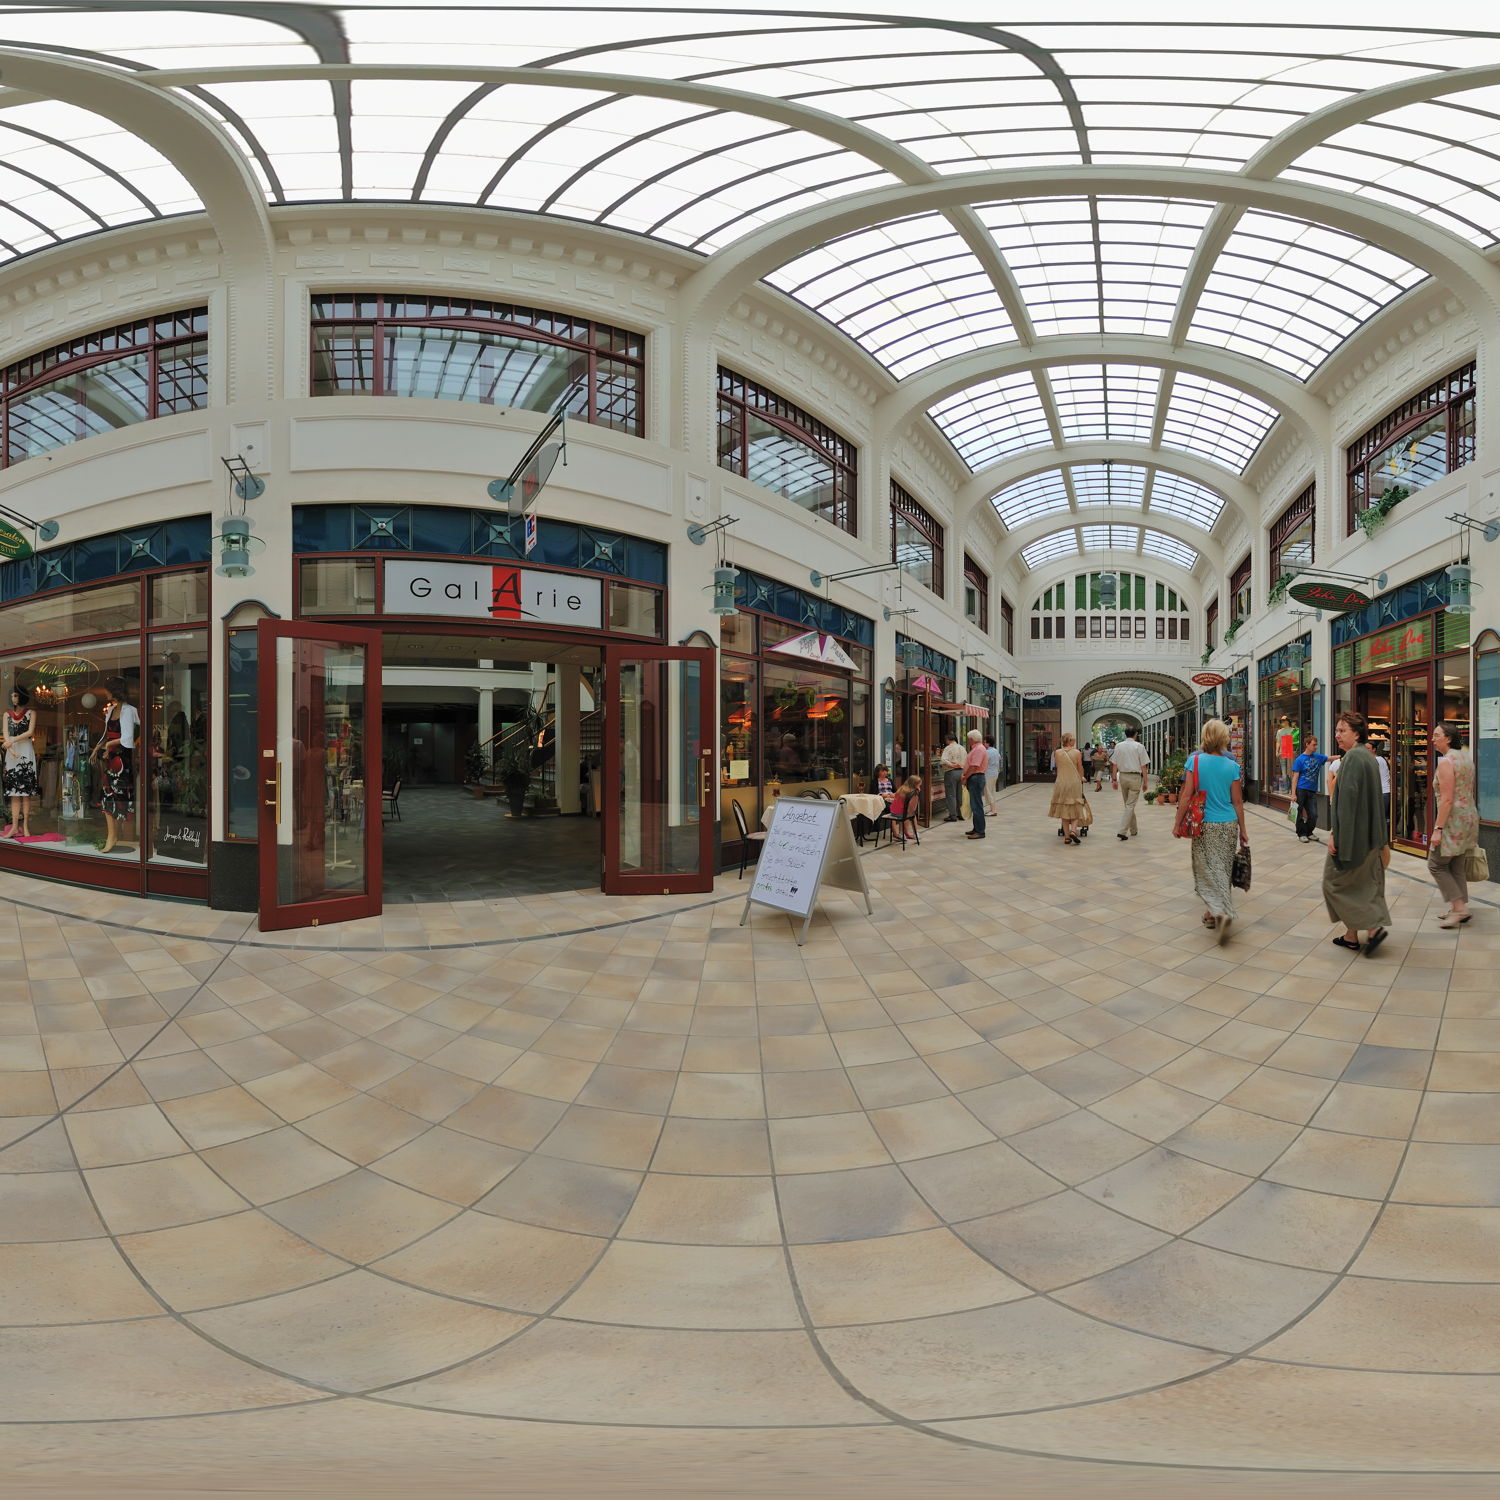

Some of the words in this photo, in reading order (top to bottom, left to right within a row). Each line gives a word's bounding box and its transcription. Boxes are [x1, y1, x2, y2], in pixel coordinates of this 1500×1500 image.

[410, 572, 581, 611] GalArie
[782, 806, 817, 823] Angebot
[163, 825, 182, 843] Joseph
